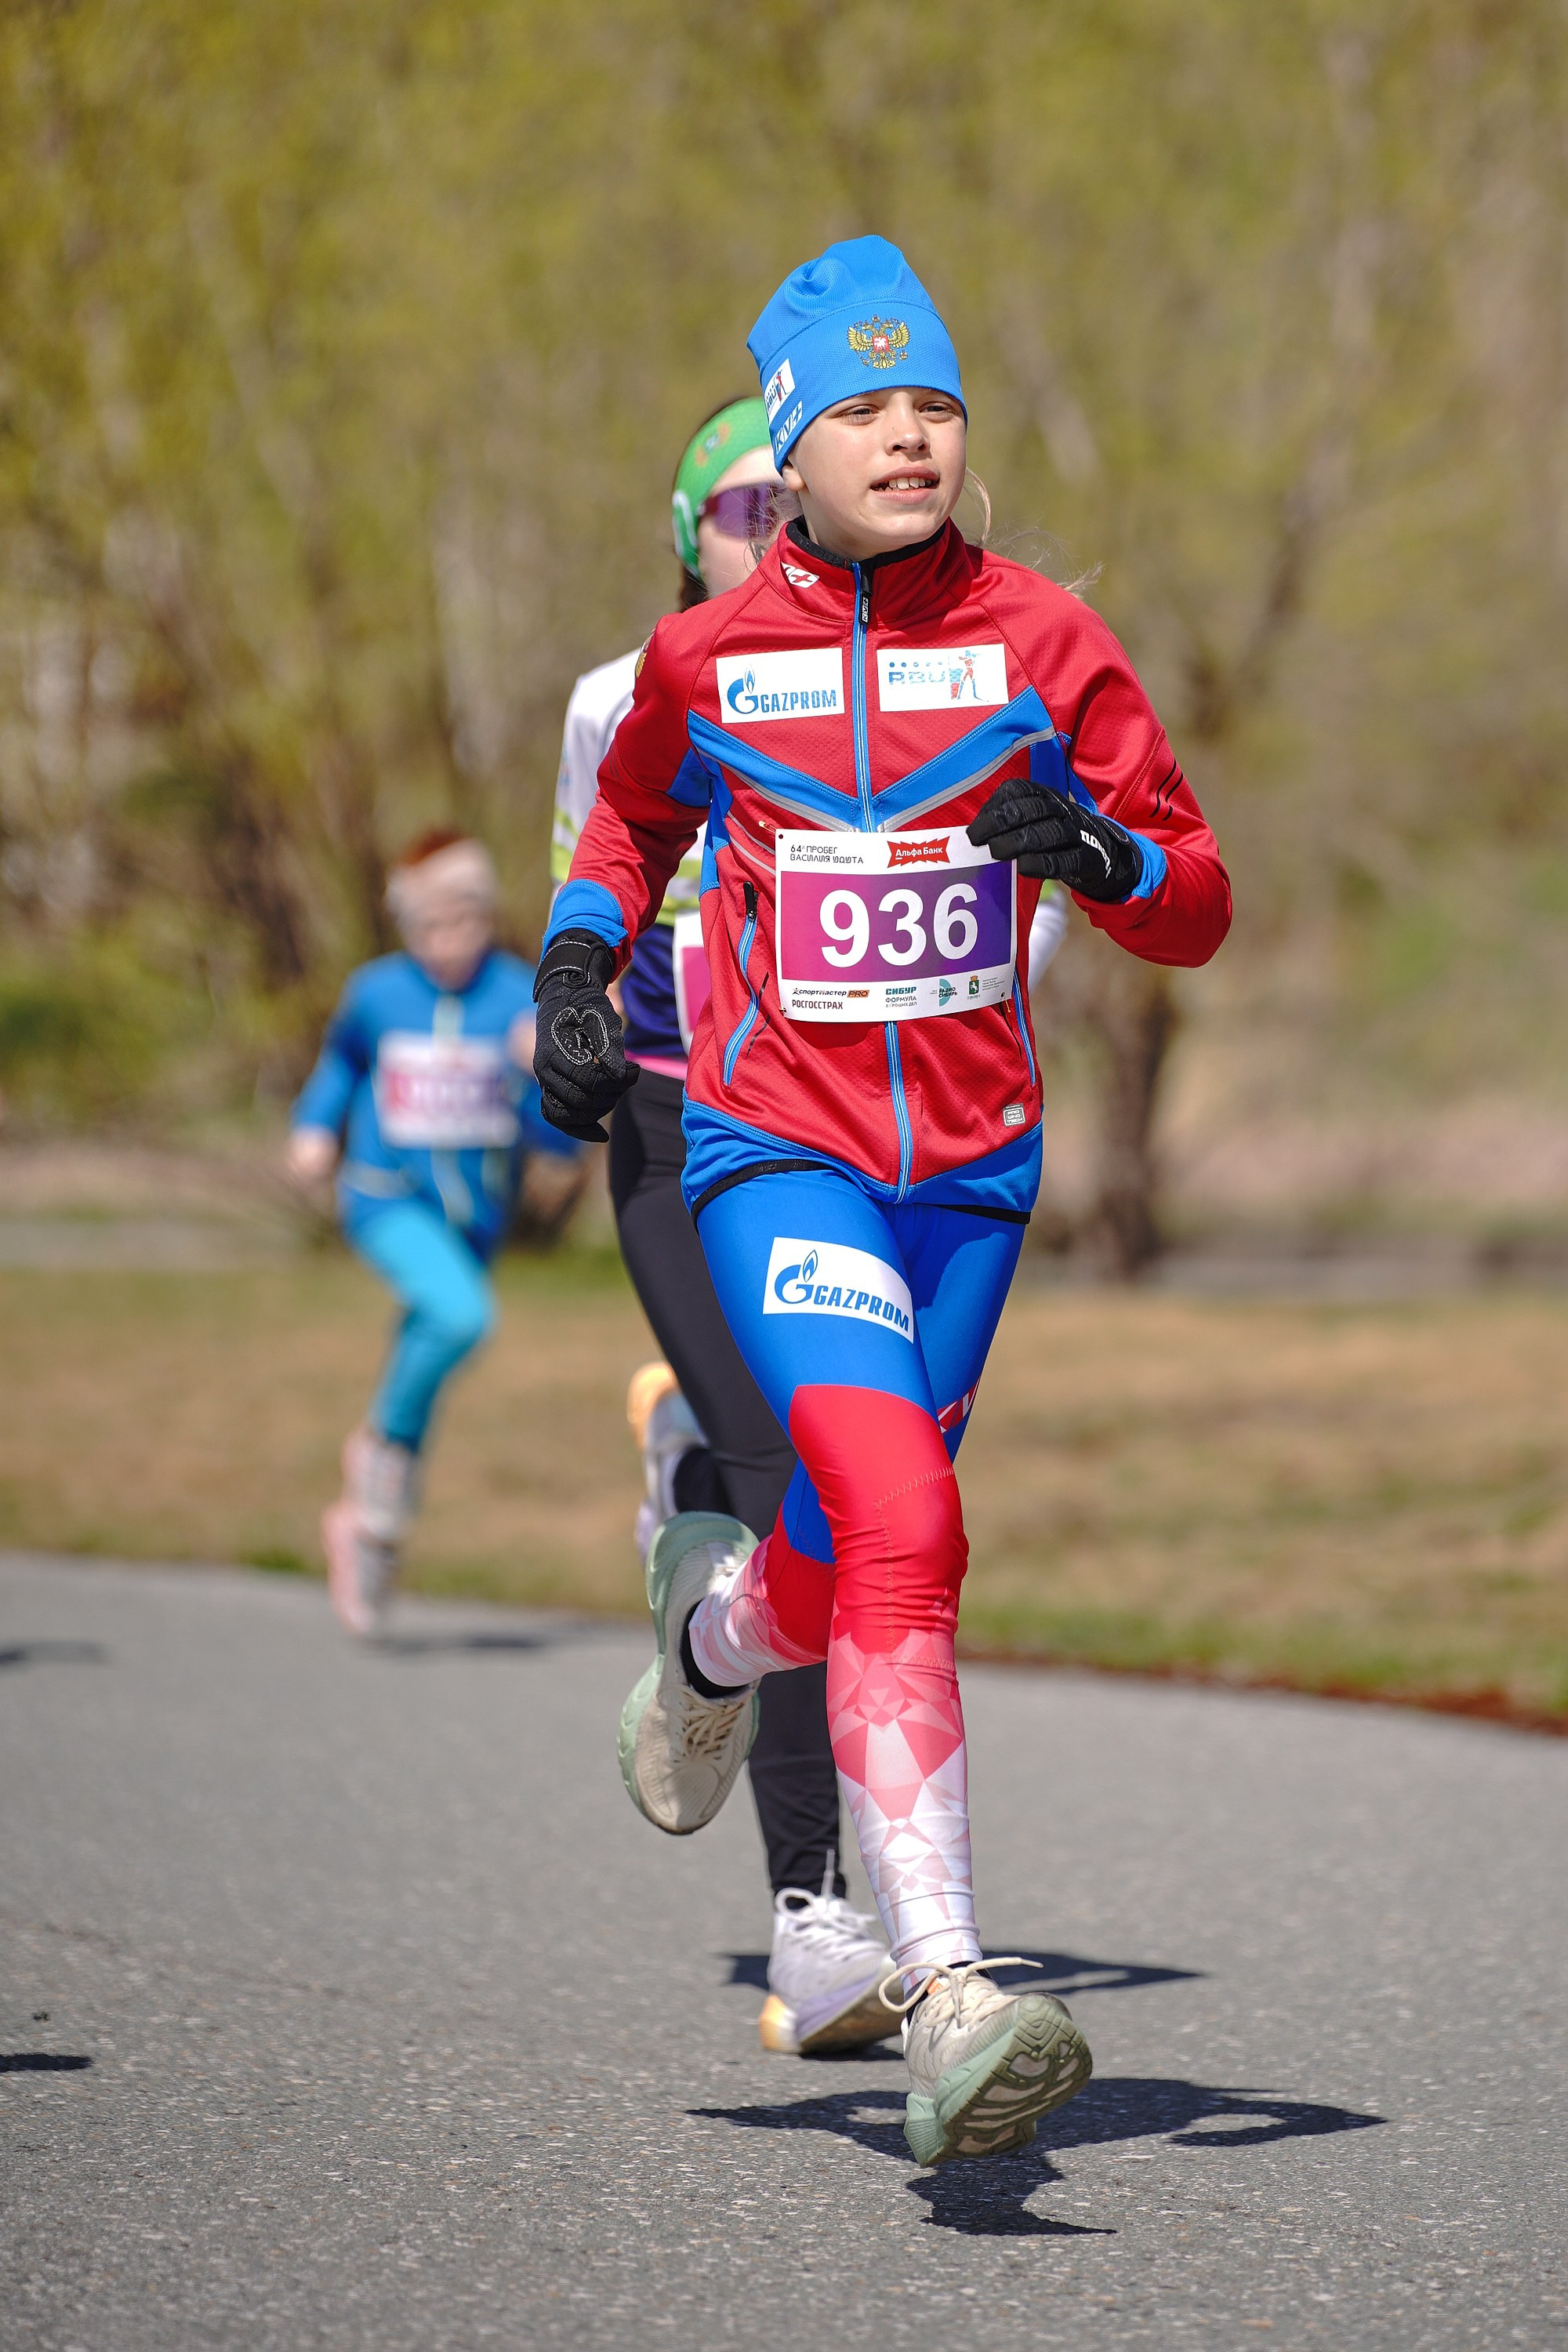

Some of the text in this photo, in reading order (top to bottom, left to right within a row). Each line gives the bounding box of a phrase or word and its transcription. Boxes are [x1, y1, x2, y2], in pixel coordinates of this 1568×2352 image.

[760, 690, 837, 713] GAZPROM
[806, 846, 838, 855] ПРОБЕГ
[895, 847, 943, 858] Альфа Банк
[790, 853, 830, 863] ВАСИЛИЯ
[819, 883, 978, 967] 936
[885, 986, 917, 996] СИБУР
[792, 1000, 844, 1010] РОСГОССТРАХ
[813, 1285, 909, 1333] GAZPROM
